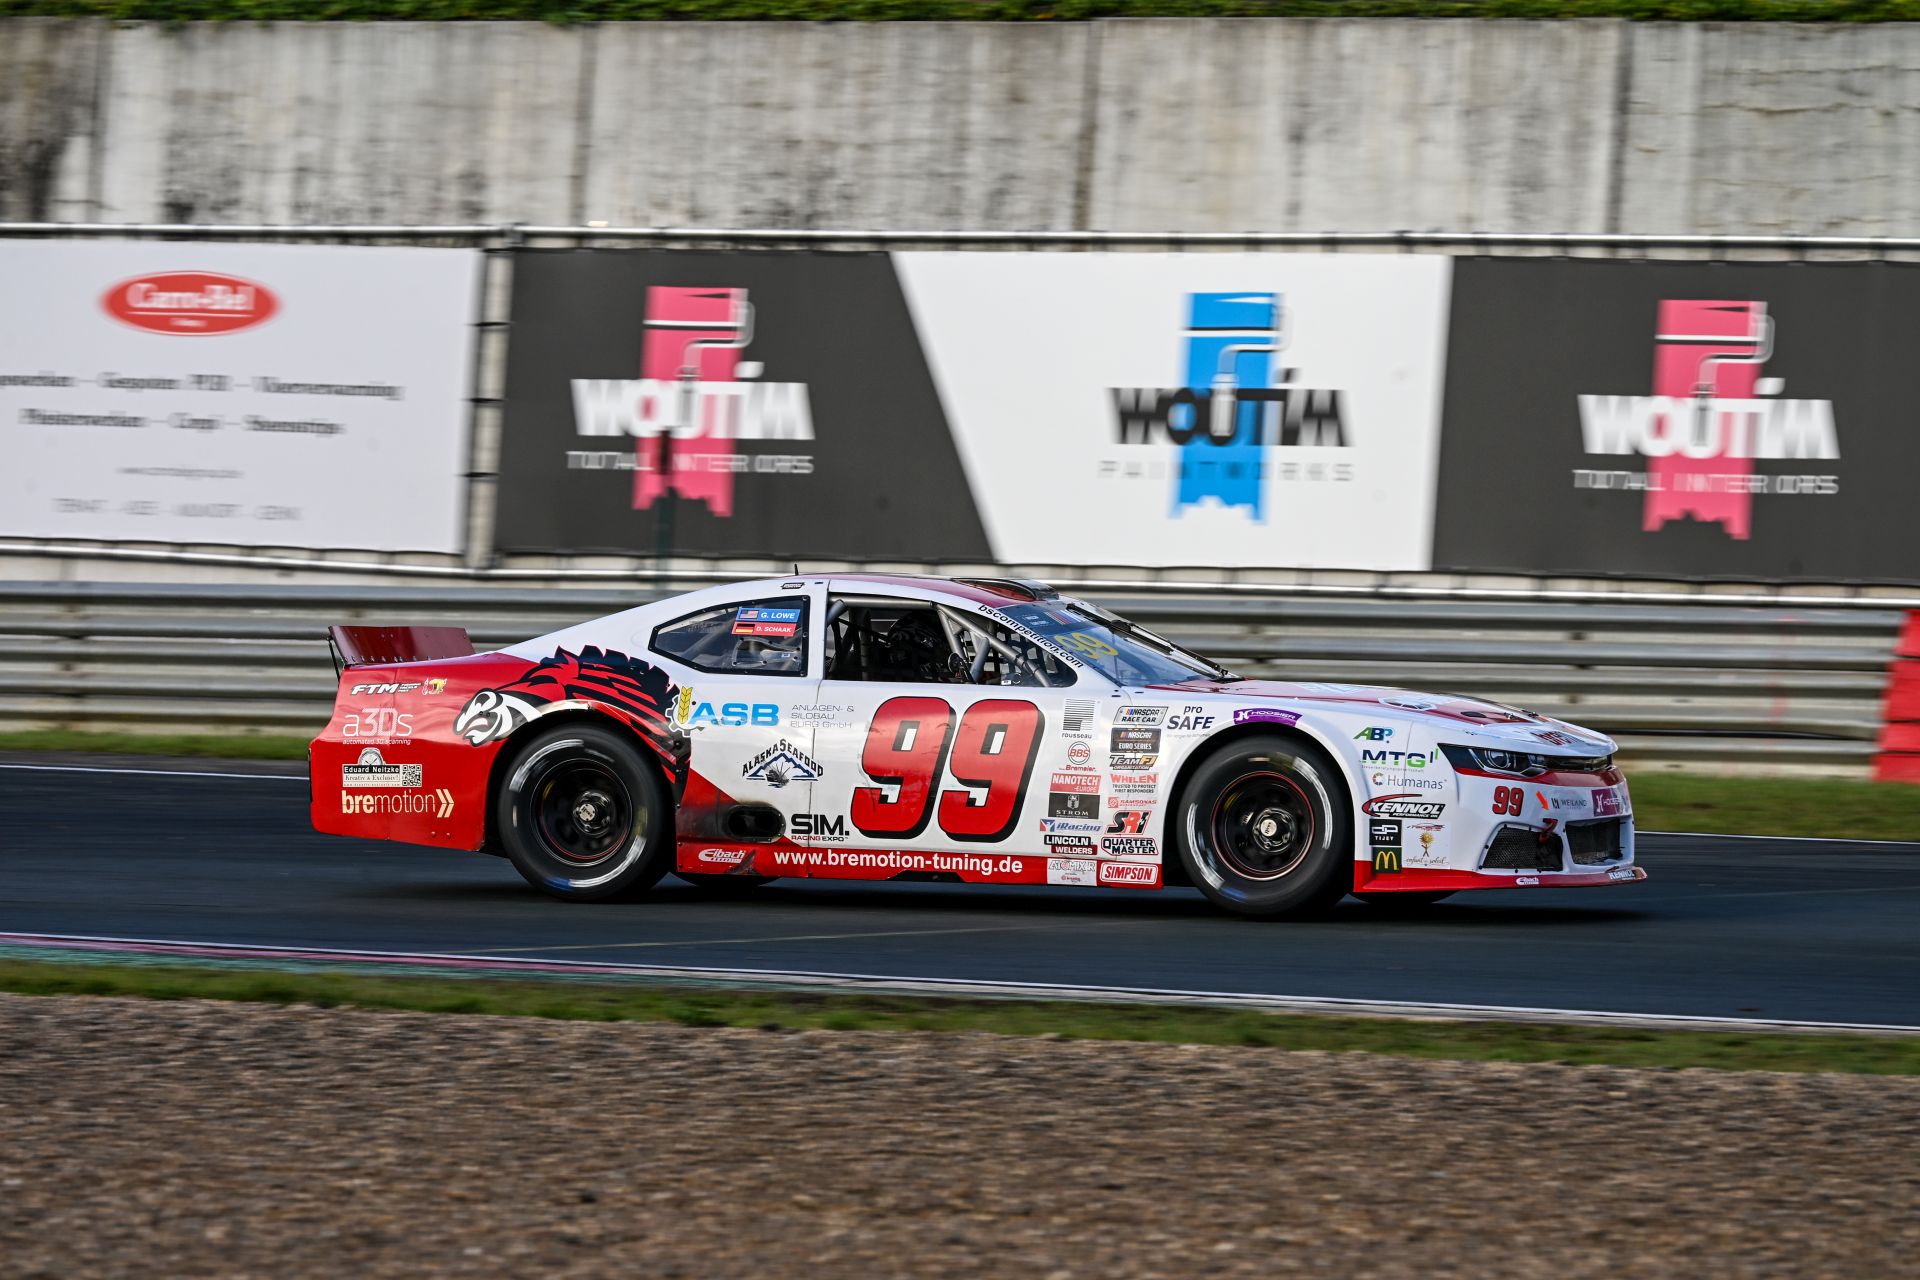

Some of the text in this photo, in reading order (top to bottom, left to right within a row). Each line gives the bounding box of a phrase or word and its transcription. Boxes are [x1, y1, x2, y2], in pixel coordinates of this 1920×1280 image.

[352, 683, 400, 695] FTM
[687, 702, 779, 727] ASB
[1184, 705, 1203, 715] pro
[1141, 716, 1156, 724] CAR
[1167, 715, 1215, 730] SAFE
[1134, 742, 1152, 750] SERIES
[1070, 748, 1089, 758] BBS
[742, 743, 779, 778] ALASKA
[851, 696, 1045, 843] 99
[1052, 774, 1099, 786] NANOTECH
[1110, 773, 1157, 783] WHELEN
[1387, 774, 1443, 789] Humanas
[342, 789, 436, 813] bremotion
[1492, 786, 1524, 817] 99
[1056, 809, 1088, 817] STROM
[1370, 802, 1442, 814] KENNOL
[1057, 821, 1101, 832] iRacing
[1046, 836, 1089, 846] LINCOLN
[1103, 838, 1153, 849] QUARTER
[774, 849, 1023, 875] www.bremotion-tuning.de
[1104, 865, 1153, 880] SIMPSON
